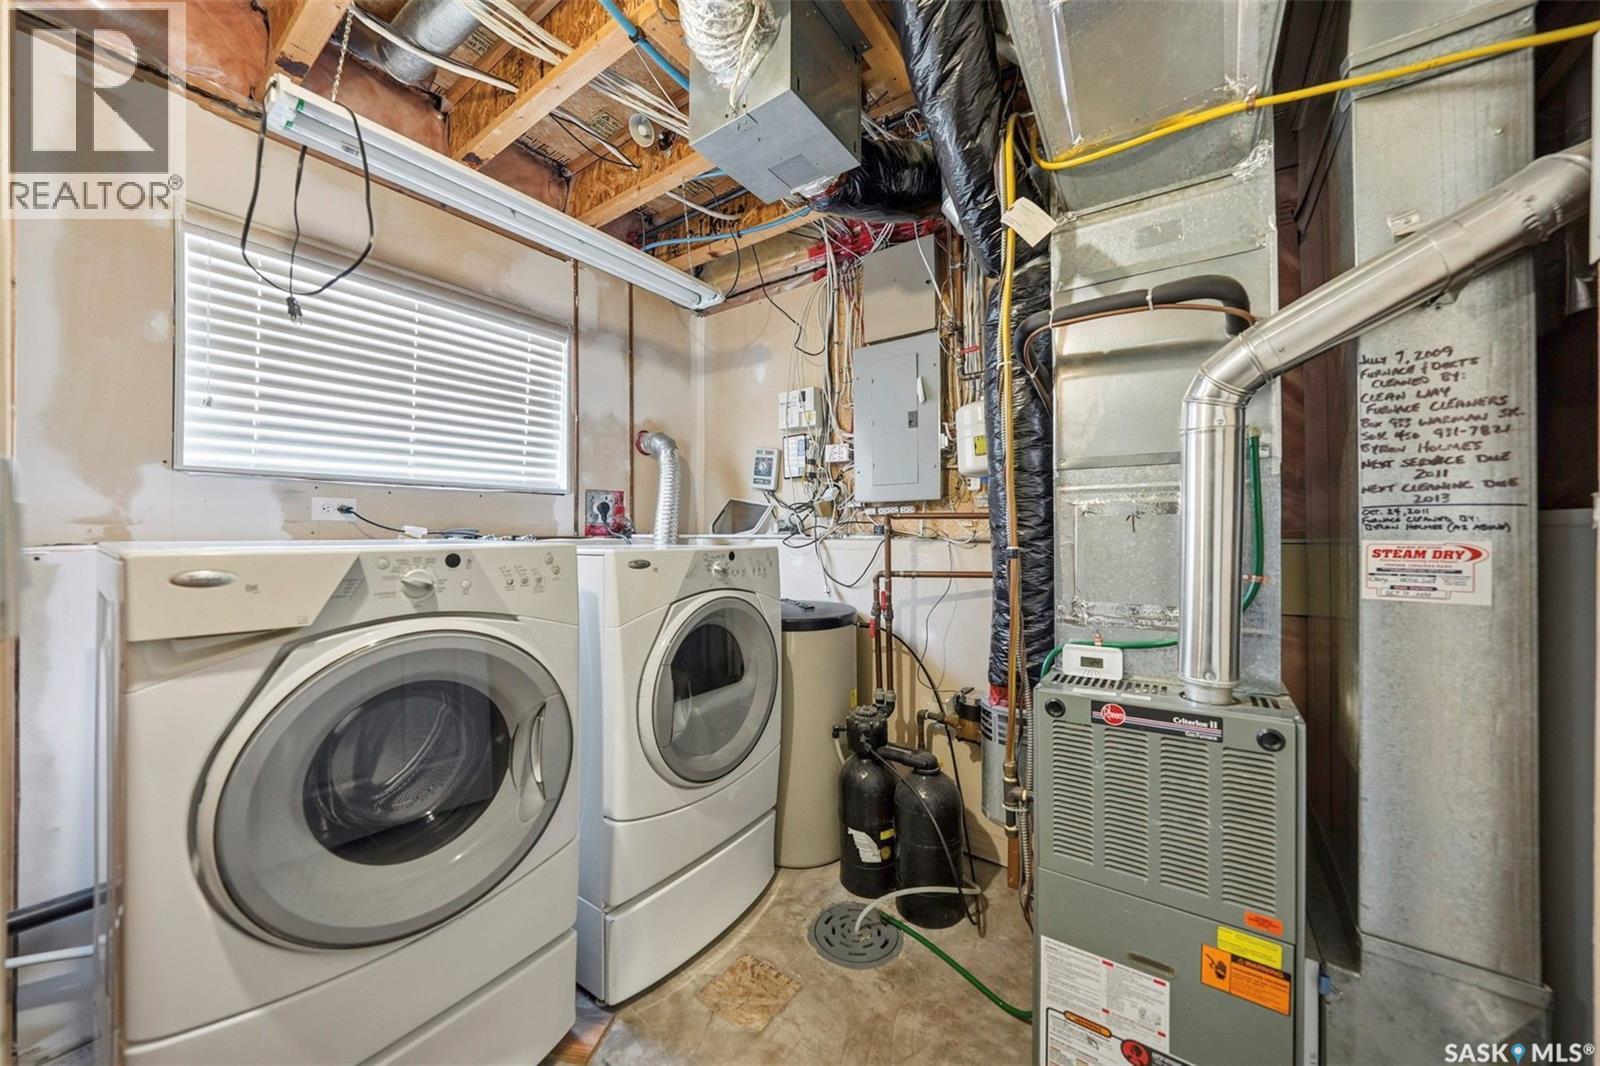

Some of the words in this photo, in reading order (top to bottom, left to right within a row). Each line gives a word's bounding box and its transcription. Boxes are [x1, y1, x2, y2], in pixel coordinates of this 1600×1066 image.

[1395, 351, 1410, 365] 7,
[1414, 346, 1454, 361] 2009
[1360, 365, 1415, 379] FURNACE
[1431, 357, 1480, 371] DUCTS
[1372, 376, 1430, 388] CLEANED
[1440, 371, 1466, 383] BY:
[1361, 392, 1406, 404] CLEAN
[1416, 387, 1451, 399] WAY
[1366, 402, 1421, 415] FURNACE
[1429, 395, 1508, 411] CLEANERS
[1418, 413, 1489, 427] WARMAN
[1360, 443, 1406, 456] BYRON
[1418, 440, 1484, 453] HOLMES
[1361, 459, 1395, 469] NEXT
[1400, 454, 1466, 468] SERVICE
[1477, 451, 1512, 463] DUE
[1414, 468, 1449, 480] 2011
[1361, 484, 1396, 494] NEXT
[1401, 480, 1474, 493] CLEANING
[1483, 477, 1520, 489] DUE
[1413, 493, 1451, 504] 2013
[1372, 549, 1426, 560] STEAM
[1432, 550, 1466, 560] DRY
[1173, 716, 1208, 728] Criterion
